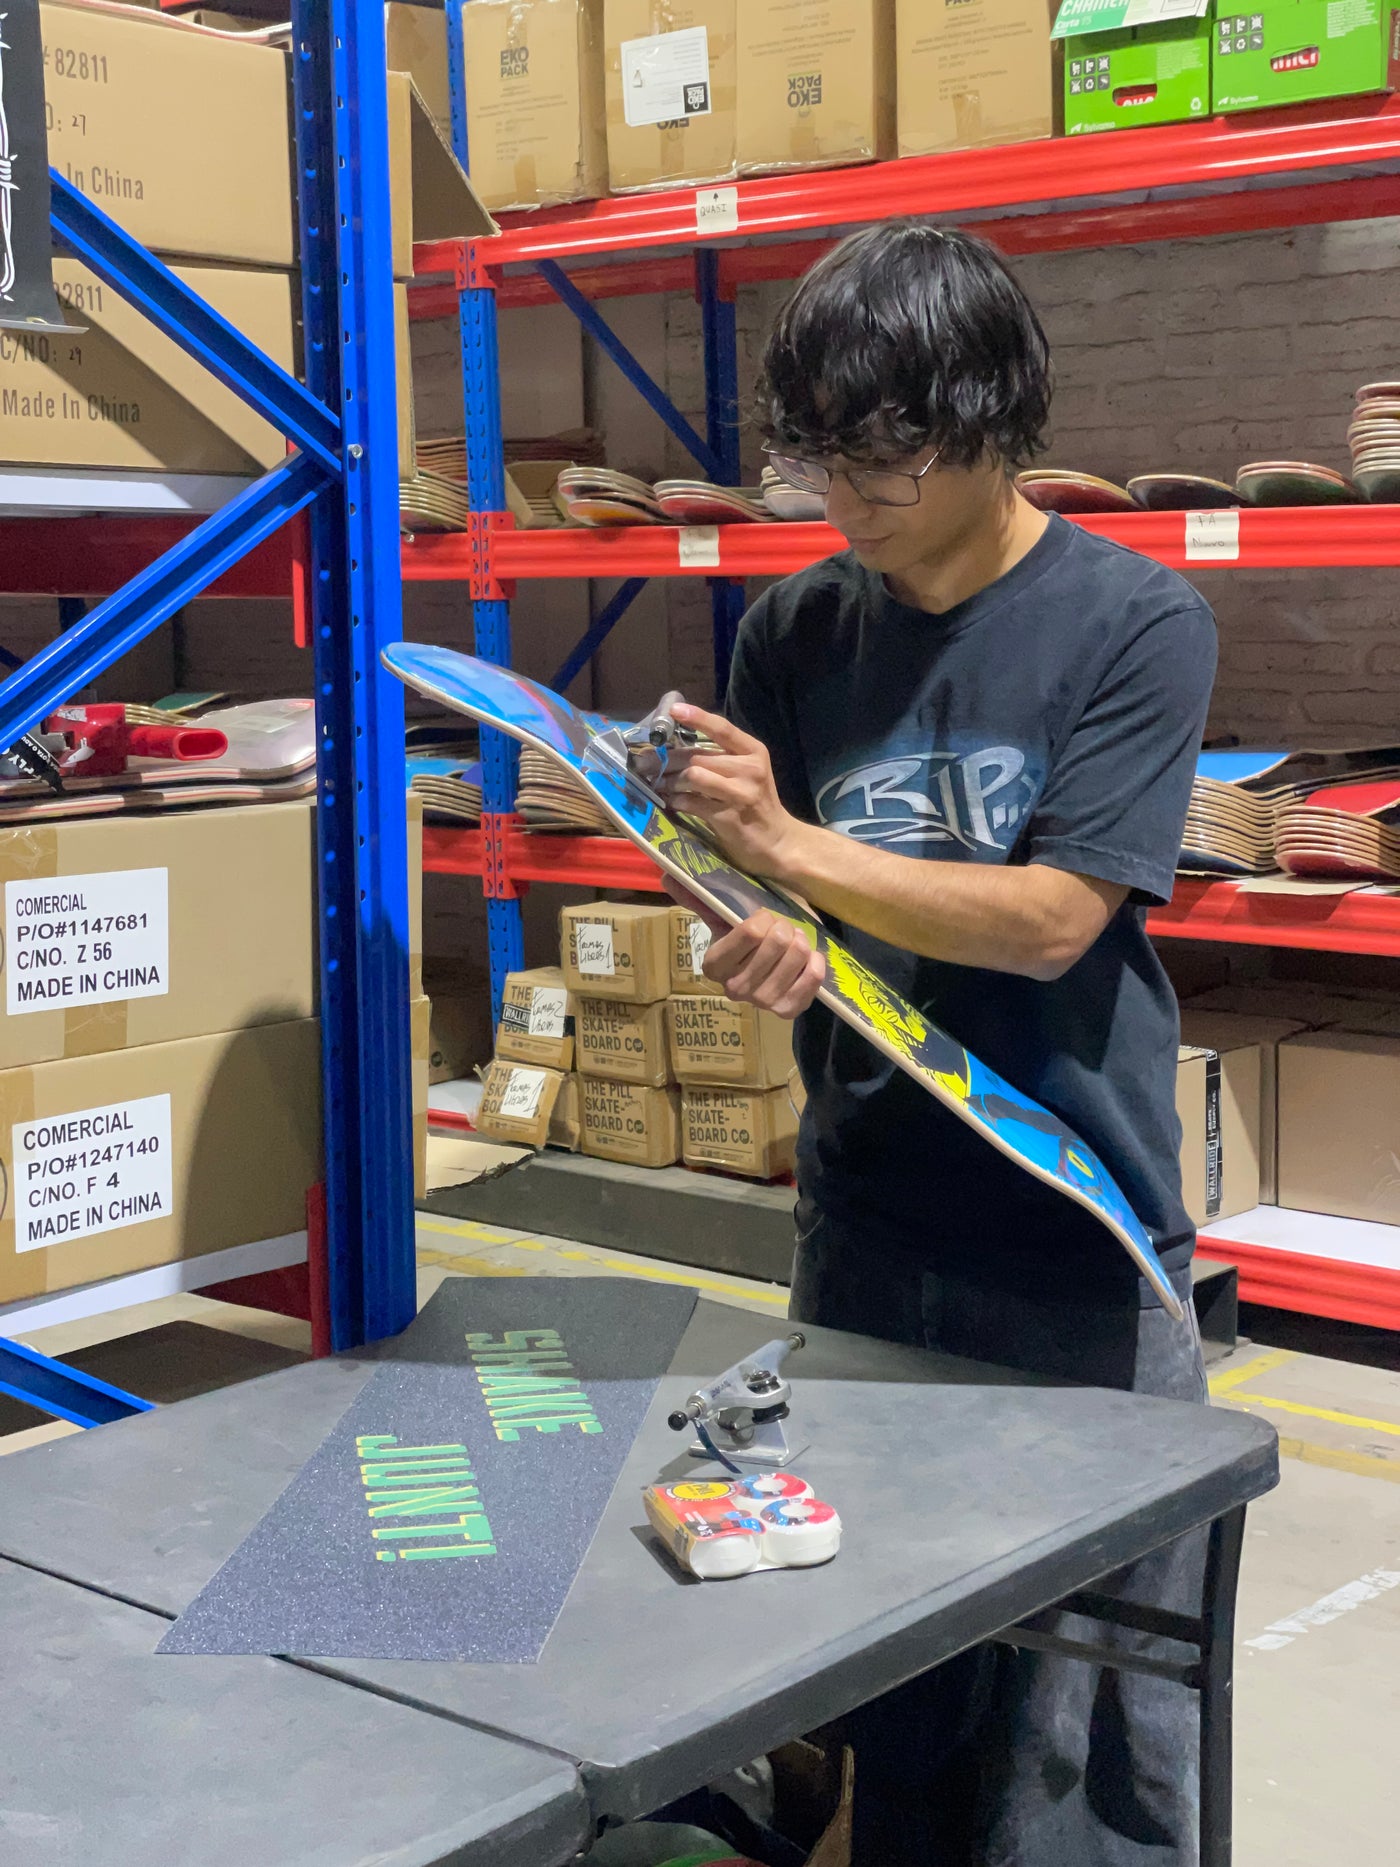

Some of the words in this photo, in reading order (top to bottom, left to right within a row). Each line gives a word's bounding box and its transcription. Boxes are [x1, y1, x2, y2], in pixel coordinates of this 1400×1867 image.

[500, 47, 529, 66] EKO
[501, 63, 529, 78] PACK
[787, 74, 822, 90] PACK
[787, 87, 822, 108] EKO
[92, 166, 144, 200] China
[0, 334, 57, 363] C/NO:
[3, 389, 55, 418] Made
[63, 393, 80, 419] In
[88, 394, 140, 422] China
[16, 894, 87, 917] COMERCIAL
[17, 913, 147, 942] P/O#1147681
[17, 947, 67, 970] C/NO.
[77, 945, 86, 964] Z
[93, 942, 113, 962] 56
[17, 976, 73, 1002] MADE
[80, 973, 97, 994] IN
[103, 965, 160, 990] CHINA
[512, 986, 531, 1000] THE
[581, 1001, 603, 1016] THE
[606, 1002, 631, 1017] PILL
[674, 999, 697, 1011] THE
[701, 999, 726, 1011] PILL
[505, 1006, 531, 1024] WALLRI
[675, 1014, 719, 1028] SKATE-
[583, 1017, 624, 1033] SKATE-
[583, 1035, 621, 1050] BOARD
[676, 1032, 717, 1046] BOARD
[585, 1080, 606, 1096] THE
[609, 1082, 632, 1099] PILL
[585, 1097, 625, 1114] SKATE-
[688, 1092, 710, 1107] THE
[713, 1093, 737, 1108] PILL
[586, 1114, 622, 1131] BOARD
[689, 1109, 730, 1124] SKATE-
[23, 1111, 134, 1151] COMERCIAL
[689, 1127, 727, 1143] BOARD
[28, 1136, 159, 1181] P/O#1247140
[28, 1181, 81, 1208] C/NO.
[87, 1176, 97, 1195] F
[106, 1172, 120, 1189] 4
[28, 1210, 81, 1242] MADE
[87, 1205, 103, 1227] IN
[109, 1191, 162, 1221] CHINA
[465, 1330, 604, 1441] SHAKE
